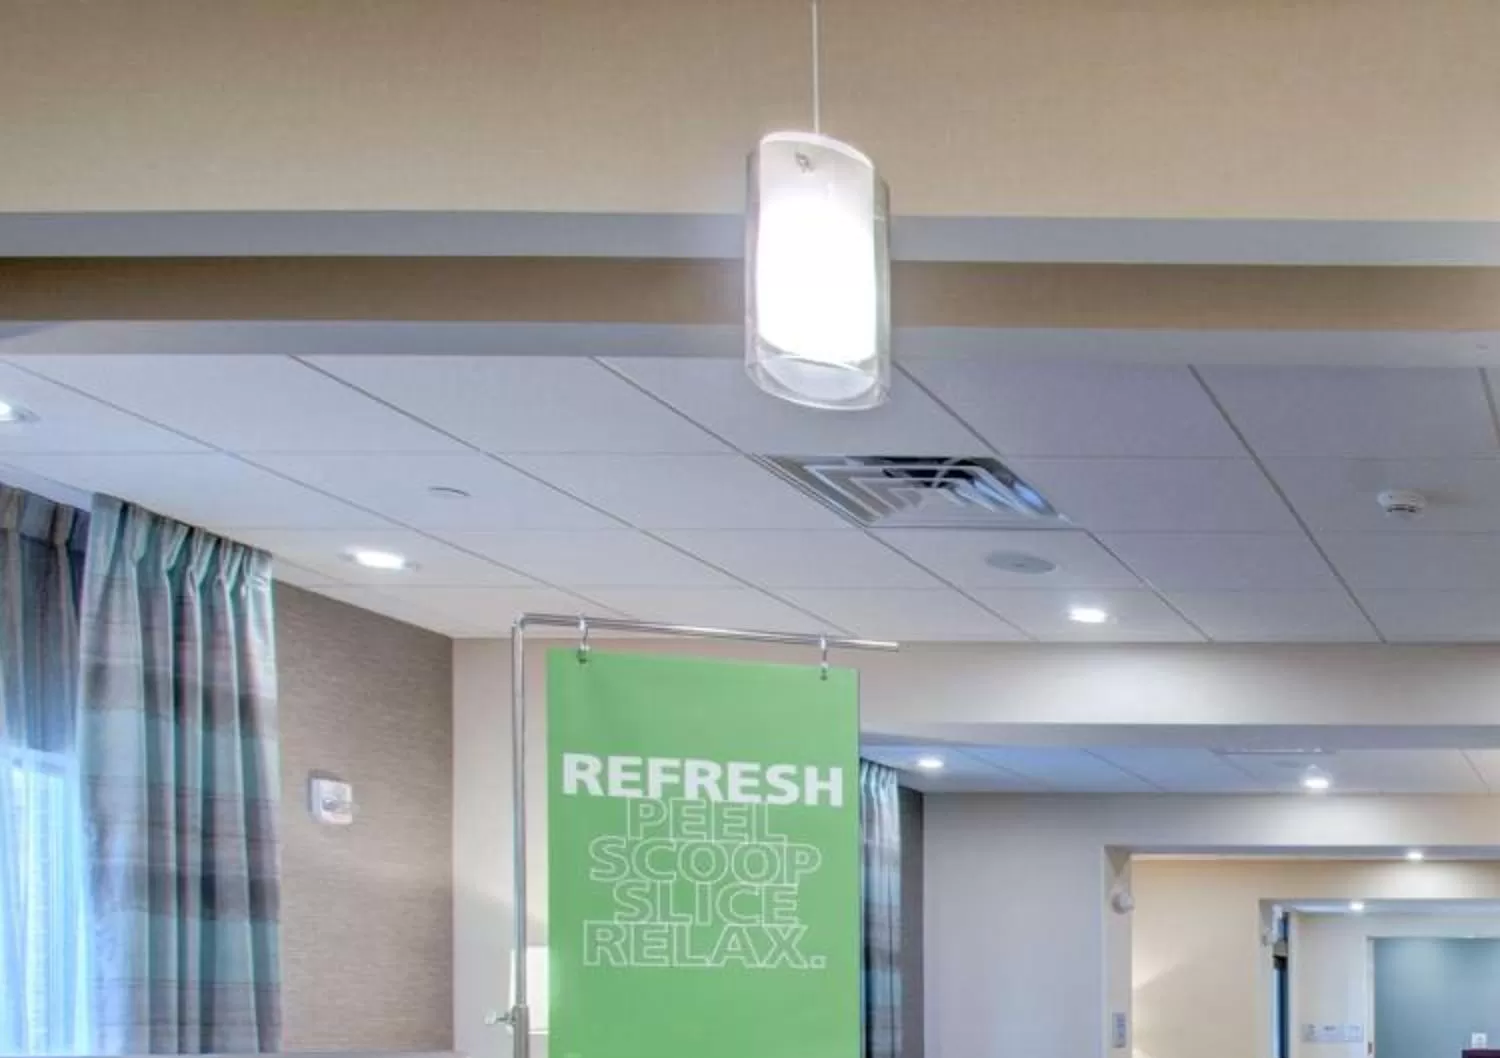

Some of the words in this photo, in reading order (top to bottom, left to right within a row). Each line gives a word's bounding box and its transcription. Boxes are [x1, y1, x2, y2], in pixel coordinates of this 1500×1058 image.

[562, 752, 844, 807] REFRESH
[627, 797, 788, 845] PEEL
[588, 835, 822, 885] SCOOP
[612, 879, 800, 926] SLICE
[582, 919, 827, 969] RELAX.
